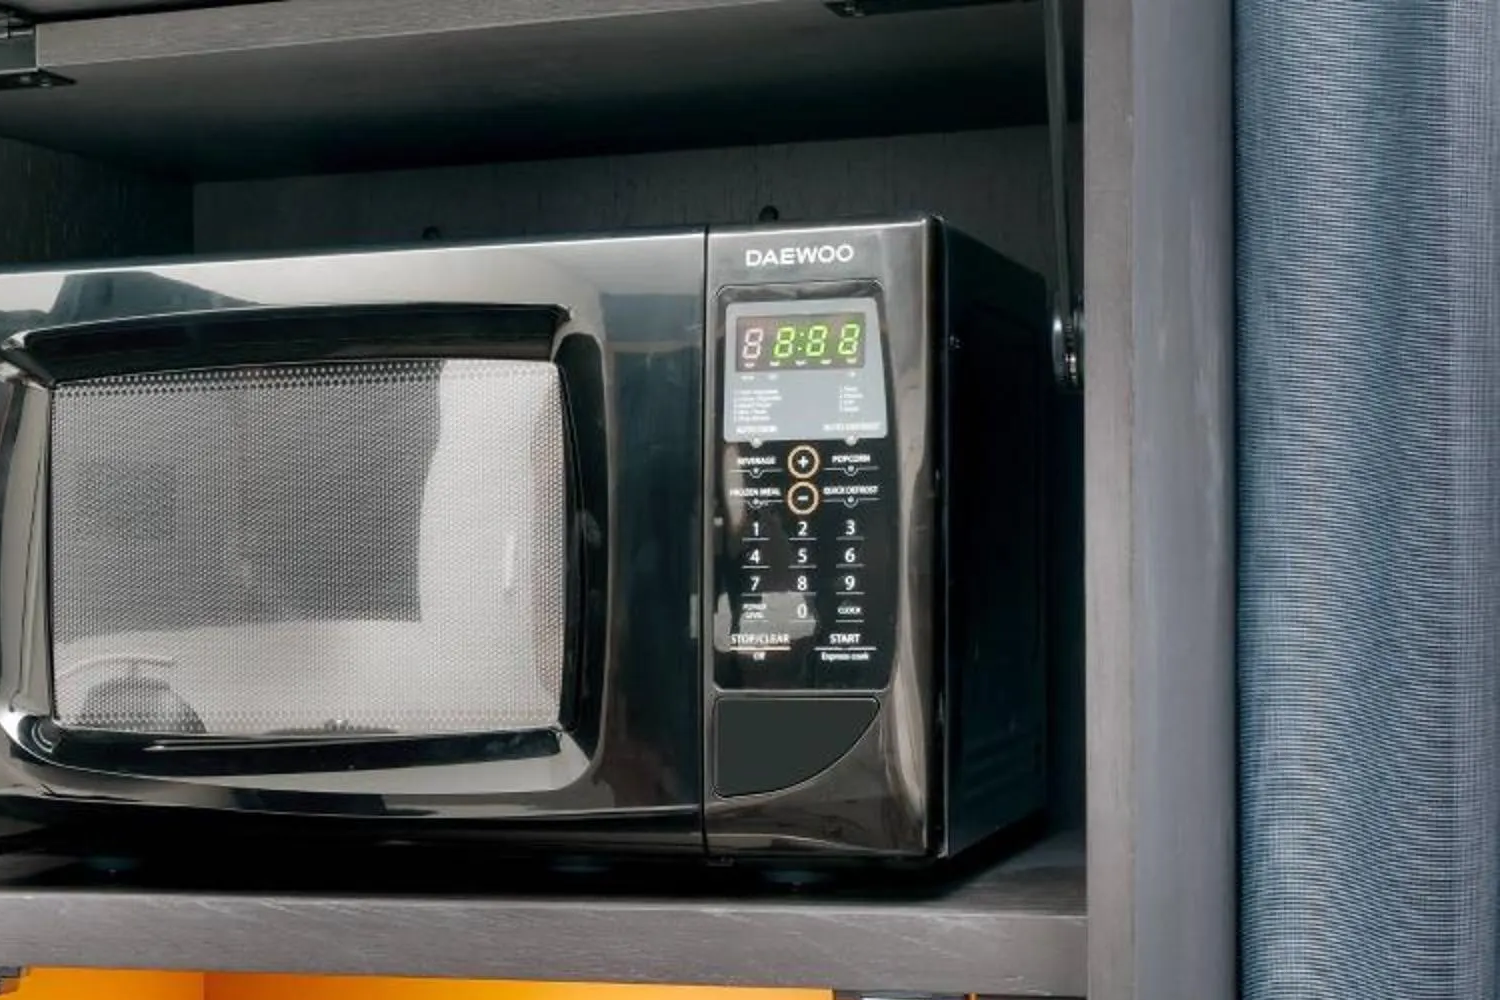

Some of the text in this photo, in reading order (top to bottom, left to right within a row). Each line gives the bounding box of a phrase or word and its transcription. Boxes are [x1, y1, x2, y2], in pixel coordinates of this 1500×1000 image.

[745, 244, 855, 267] DAEWOO
[832, 454, 871, 463] POPCORN
[752, 522, 759, 536] 1
[797, 522, 808, 536] 2
[845, 520, 856, 535] 3
[749, 549, 760, 564] 4
[797, 548, 807, 563] 5
[845, 548, 856, 563] 6
[750, 577, 760, 591] 7
[797, 576, 808, 591] 8
[845, 576, 856, 590] 9
[797, 603, 808, 618] 0
[829, 633, 861, 644] START
